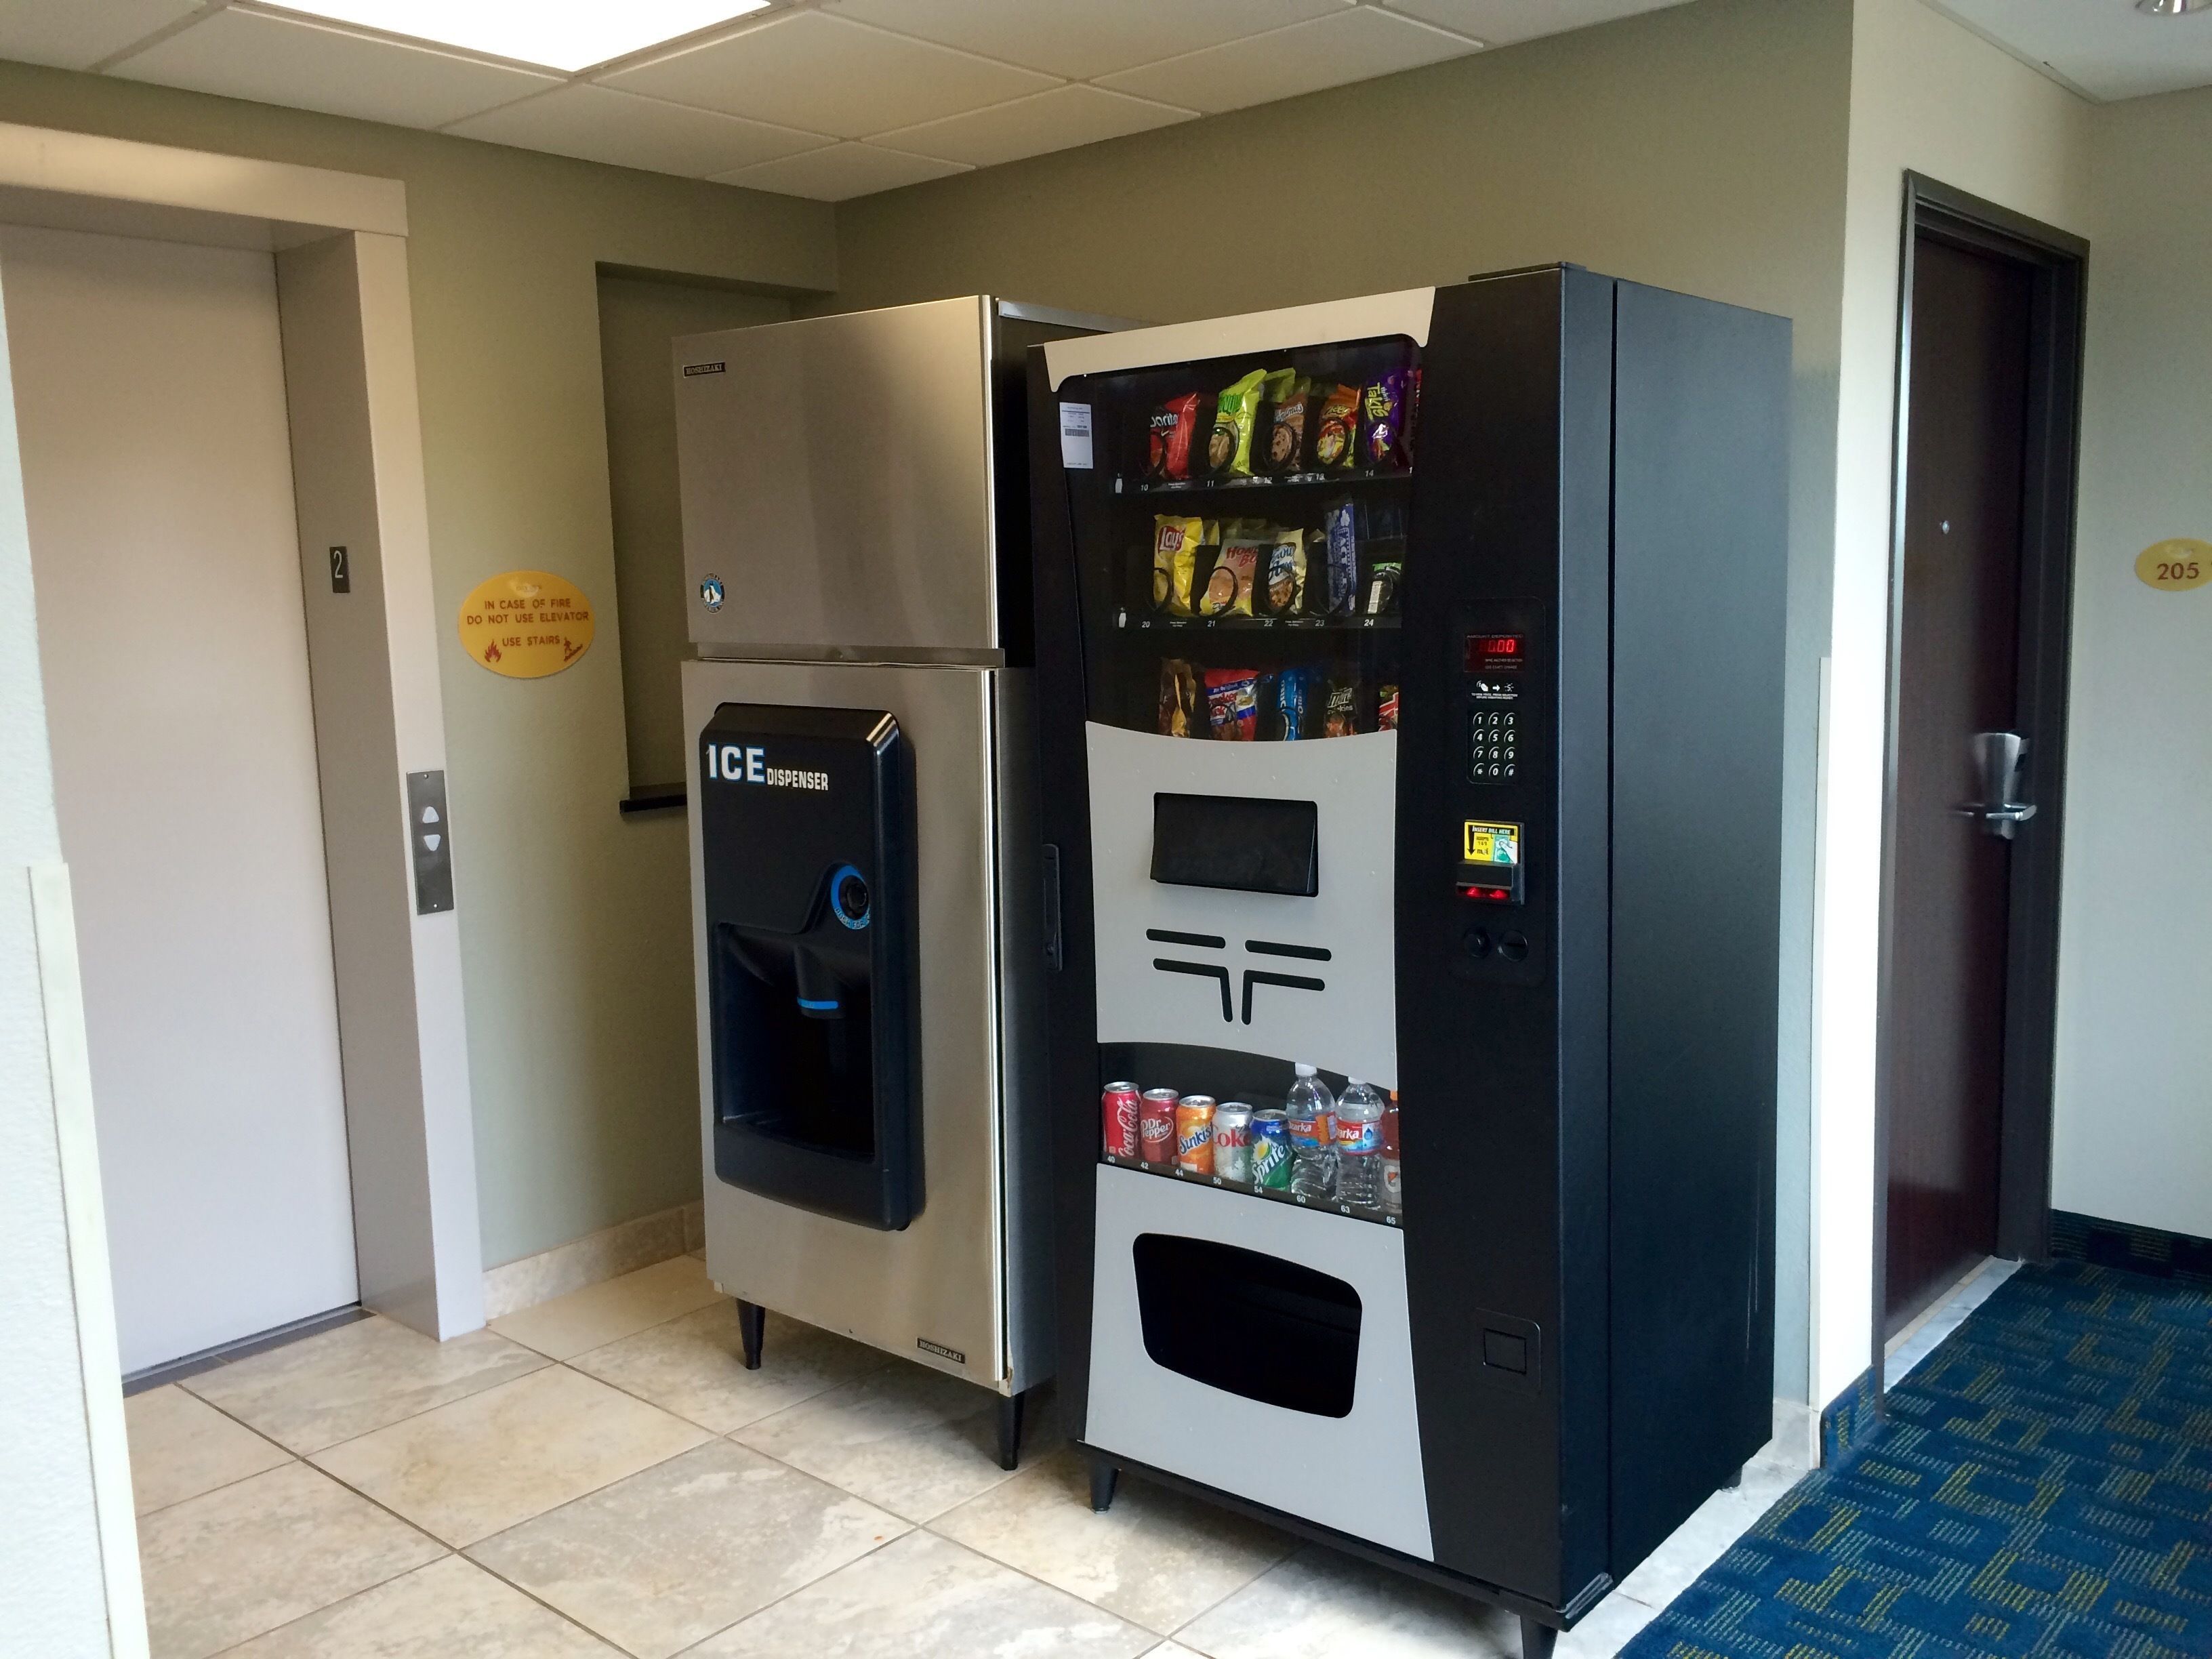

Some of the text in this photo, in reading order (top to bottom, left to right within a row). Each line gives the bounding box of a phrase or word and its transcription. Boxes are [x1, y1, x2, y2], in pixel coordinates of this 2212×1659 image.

[333, 550, 343, 578] 2
[1239, 554, 1257, 567] BU
[2157, 562, 2199, 579] 205
[485, 598, 571, 610] IN CASE OF FIRE
[467, 611, 590, 625] DO NOT USE ELEVATOR
[1364, 619, 1374, 627] 24
[502, 635, 560, 647] USE STAIRS
[1478, 716, 1514, 725] 1 2 3
[1477, 733, 1514, 742] 4 5 6
[1477, 750, 1514, 759] 7 8 9
[708, 744, 829, 791] ICE DISPENSER
[1492, 768, 1498, 776] 0
[1118, 1097, 1138, 1158] Coca-Cola
[1148, 1118, 1162, 1128] Dr
[1140, 1120, 1171, 1140] Pepper
[1336, 1128, 1360, 1140] arka
[1179, 1121, 1214, 1155] Sunkist
[1252, 1142, 1286, 1185] Sprite
[1141, 1162, 1149, 1170] 42
[1175, 1168, 1183, 1176] 44
[1213, 1176, 1222, 1185] 50
[1254, 1185, 1263, 1193] 54
[1296, 1195, 1306, 1203] 60
[1340, 1205, 1351, 1213] 63
[1386, 1216, 1396, 1225] 65
[919, 1340, 962, 1362] HOSHIZAKI
